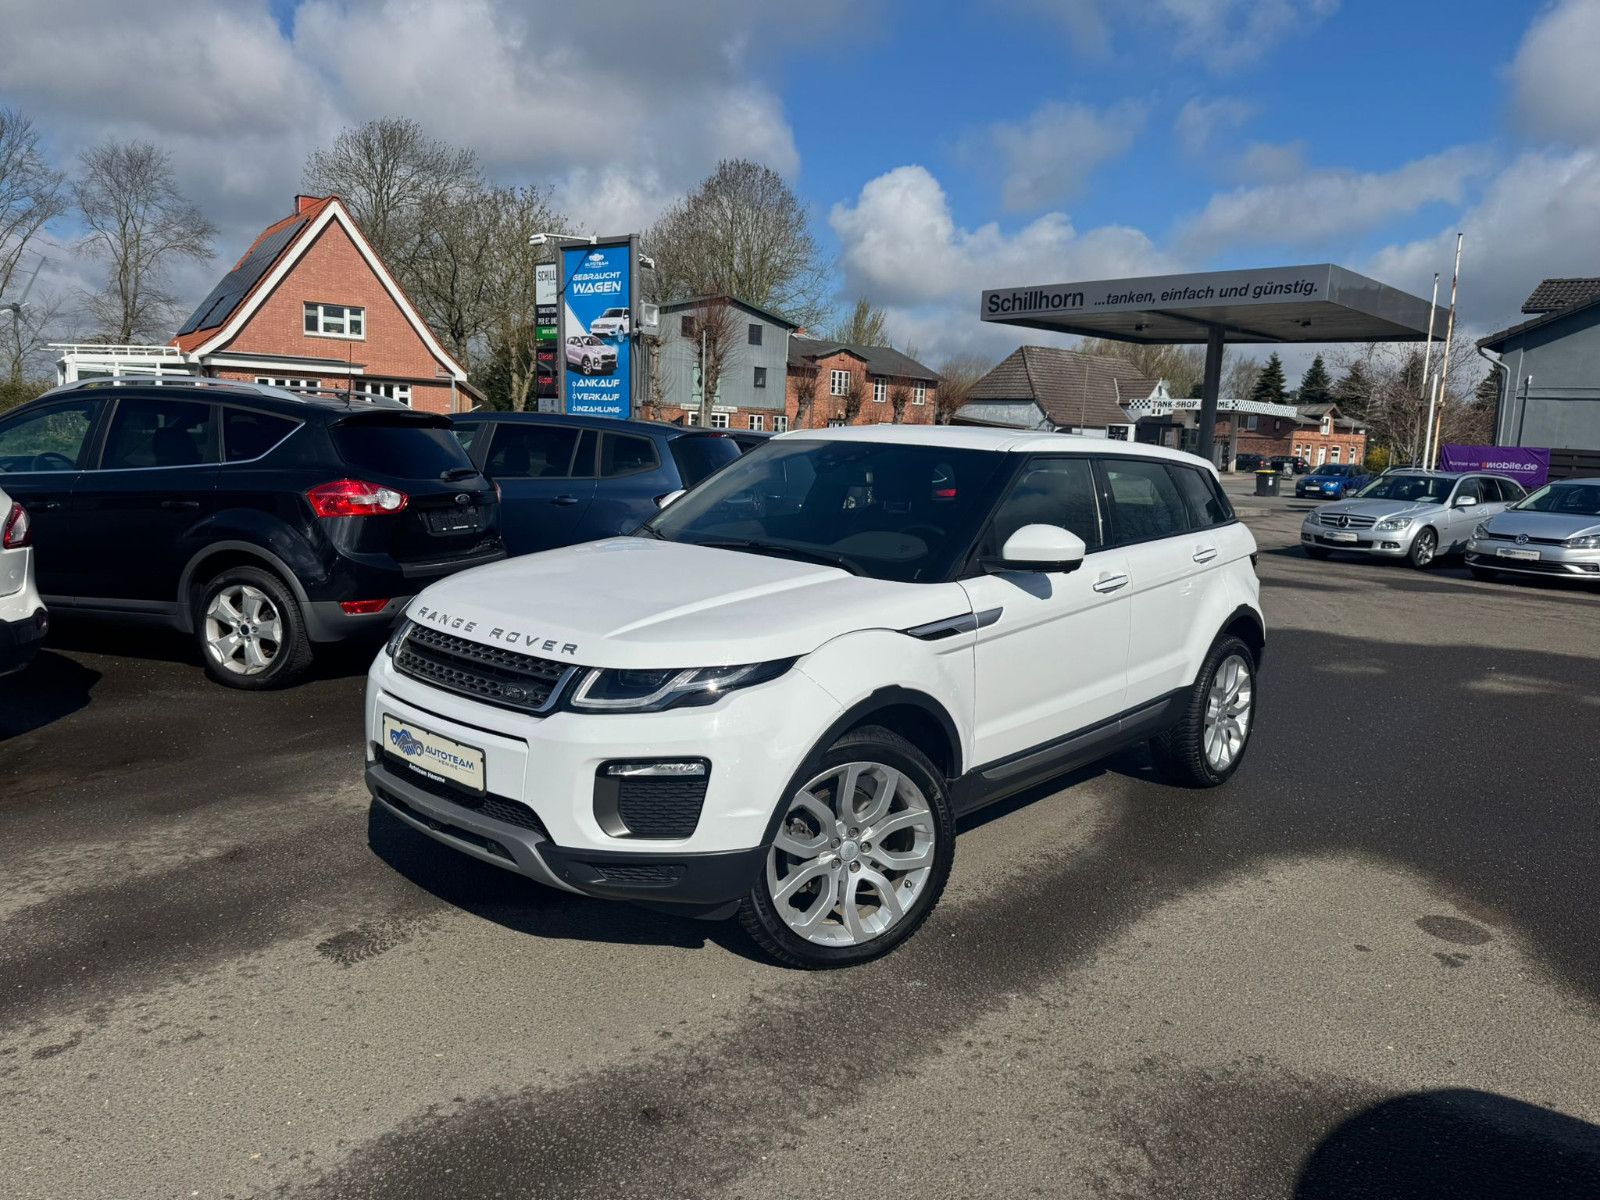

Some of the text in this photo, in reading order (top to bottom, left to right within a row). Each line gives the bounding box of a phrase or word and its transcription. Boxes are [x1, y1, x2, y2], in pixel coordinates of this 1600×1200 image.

[573, 271, 621, 281] GEBRAUCHT
[573, 281, 621, 294] WAGEN
[988, 290, 1084, 313] Schillhorn
[1160, 285, 1214, 301] einfach
[1219, 283, 1250, 298] und
[1252, 279, 1318, 299] günstig.
[576, 379, 620, 387] ANKAUF
[576, 393, 620, 401] VERKAUF
[1152, 400, 1173, 408] TANK
[1218, 401, 1230, 409] ME
[417, 606, 578, 656] RANGE ROVER
[425, 745, 474, 771] AUTOTEAM
